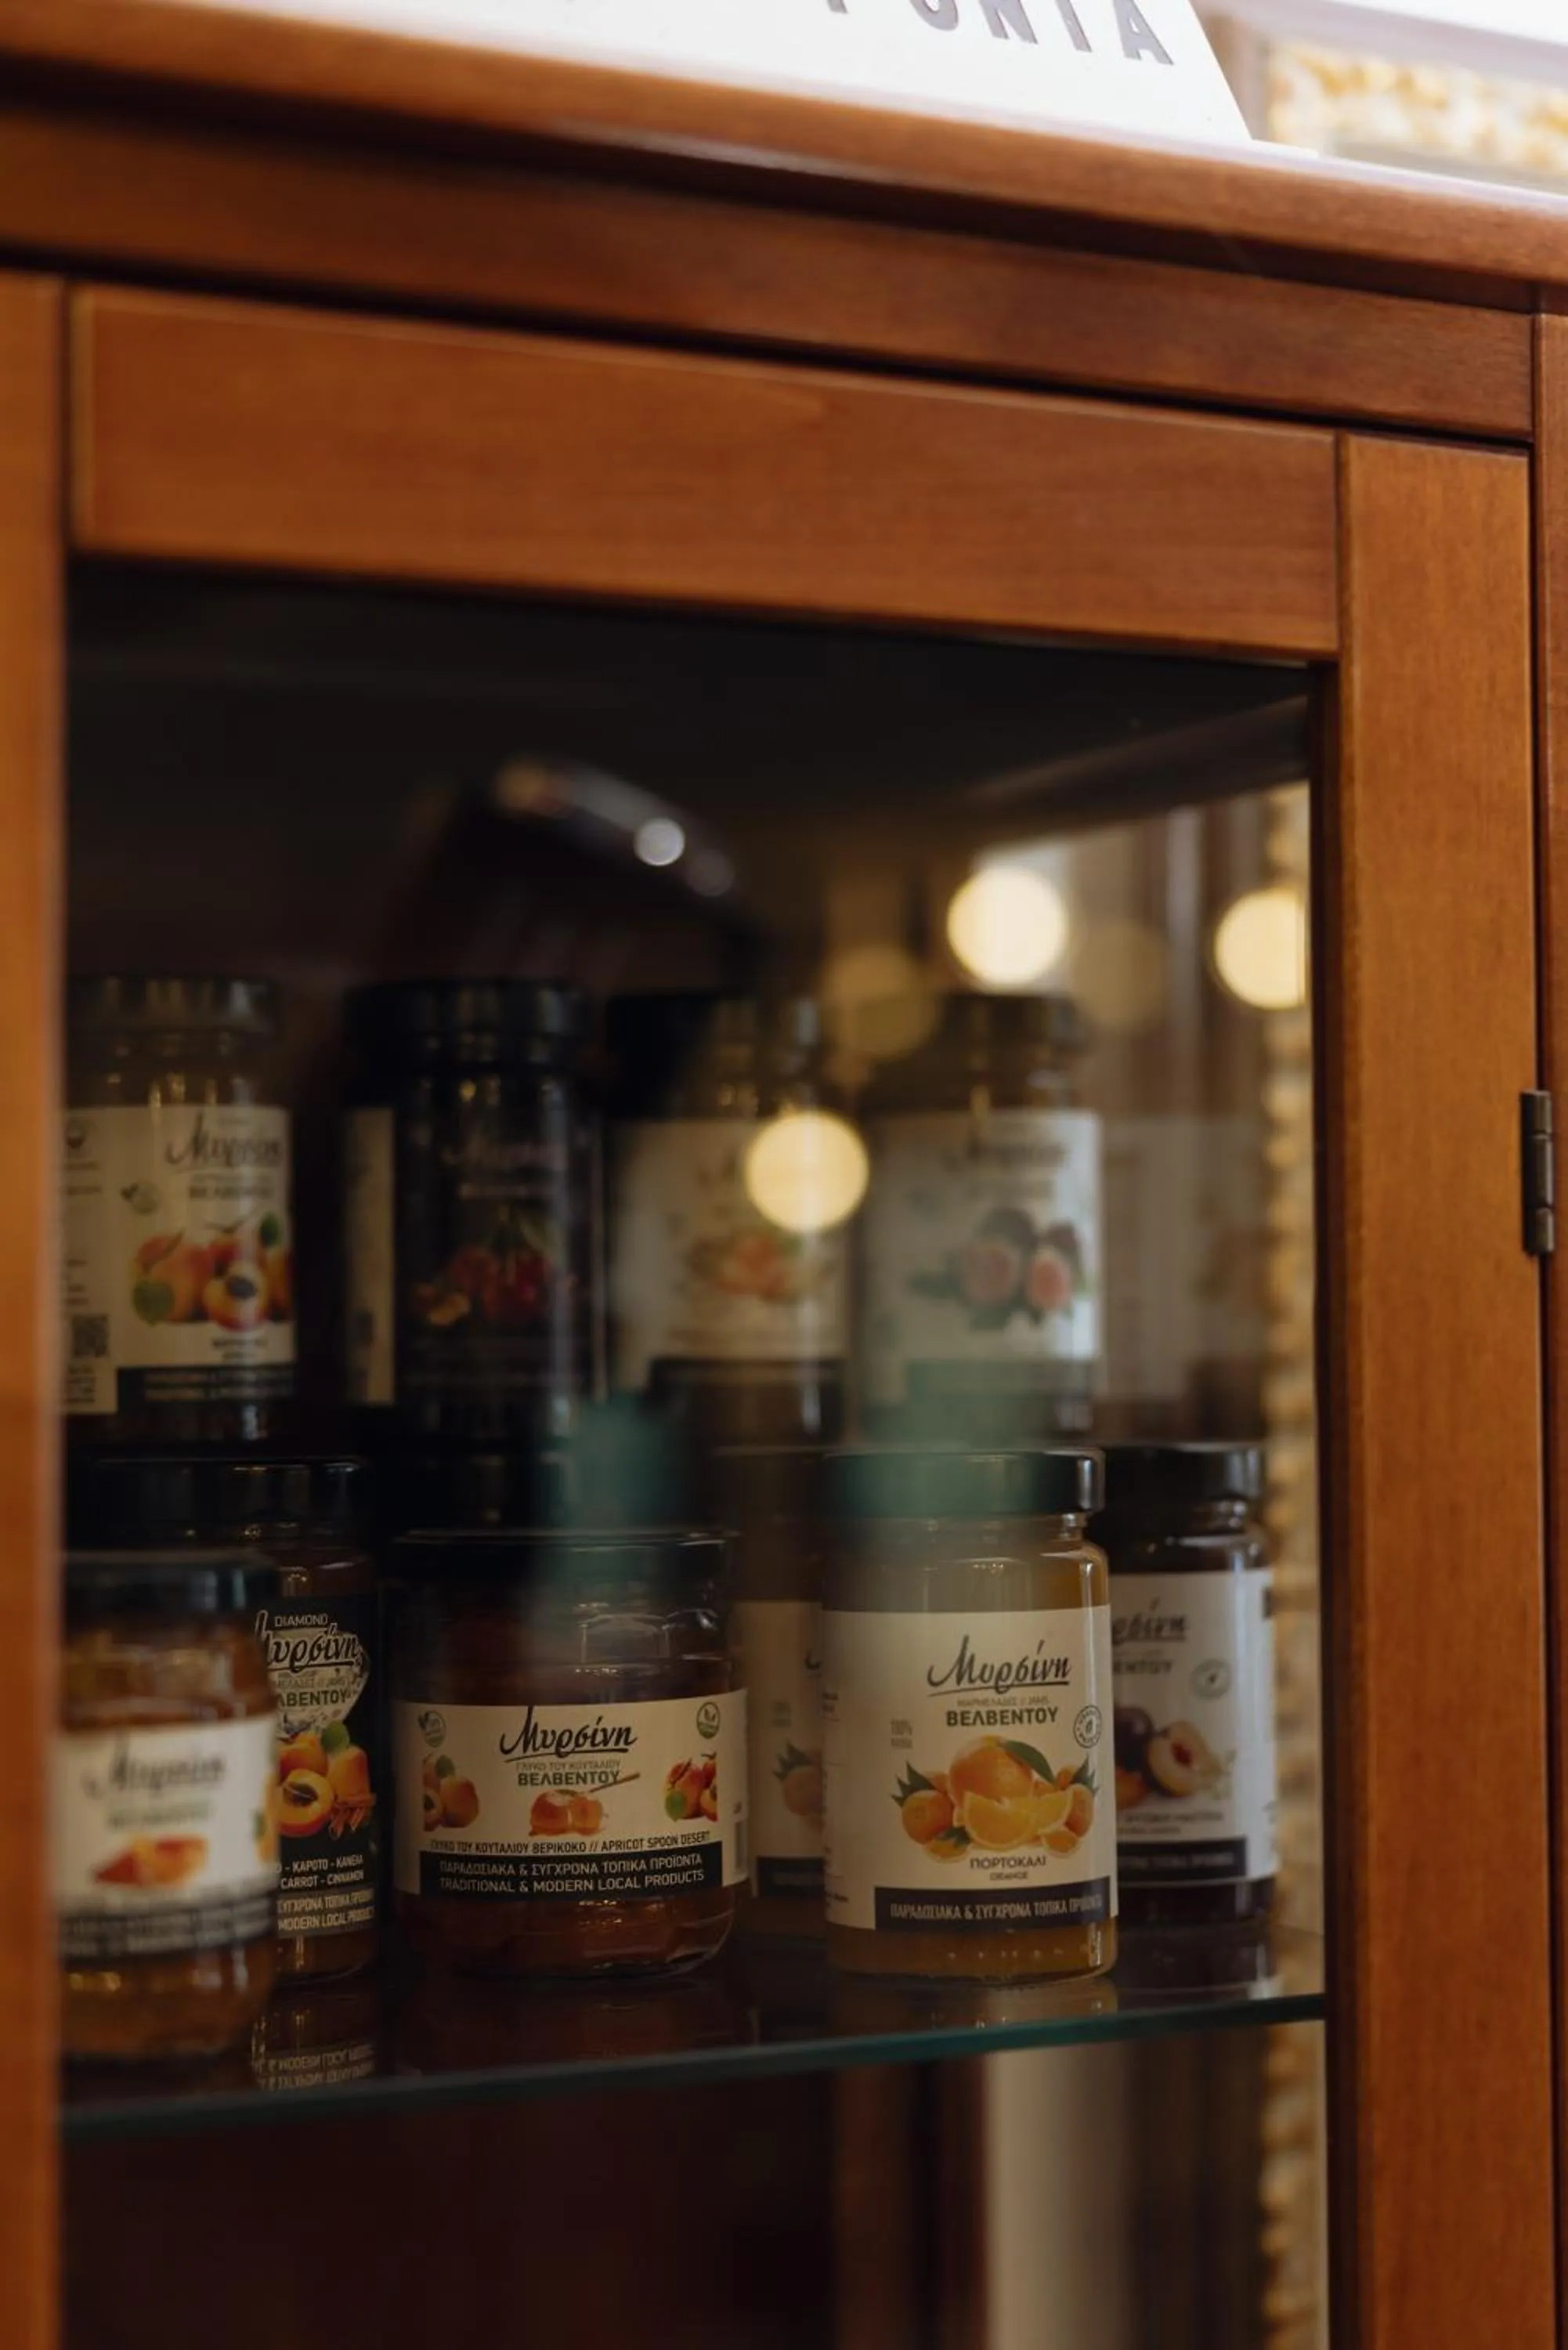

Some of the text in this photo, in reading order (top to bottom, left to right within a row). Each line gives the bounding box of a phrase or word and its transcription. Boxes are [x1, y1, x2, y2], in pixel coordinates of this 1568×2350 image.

[274, 1614, 328, 1627] DIAMOND
[276, 1690, 347, 1707] ΛΒΕΝΤΟΥ
[946, 1707, 1059, 1726] ΒΕΛΒΕΝΤΟΥ
[518, 1770, 620, 1786] ΒΕΛΒΕΝΤΟΥ
[475, 1842, 529, 1853] ΚΟΥΤΑΛΙΟΥ
[533, 1842, 587, 1853] ΒΕΡΙΚΟΚΟ
[602, 1838, 643, 1851] APRICOT
[519, 1864, 529, 1876] &
[532, 1862, 599, 1877] ΣΥΓΧΡΟΝΑ
[602, 1858, 648, 1875] ΤΟΠΙΚΑ
[439, 1868, 705, 1893] TRADITIONAL & MODERN LOCAL PRODUCTS
